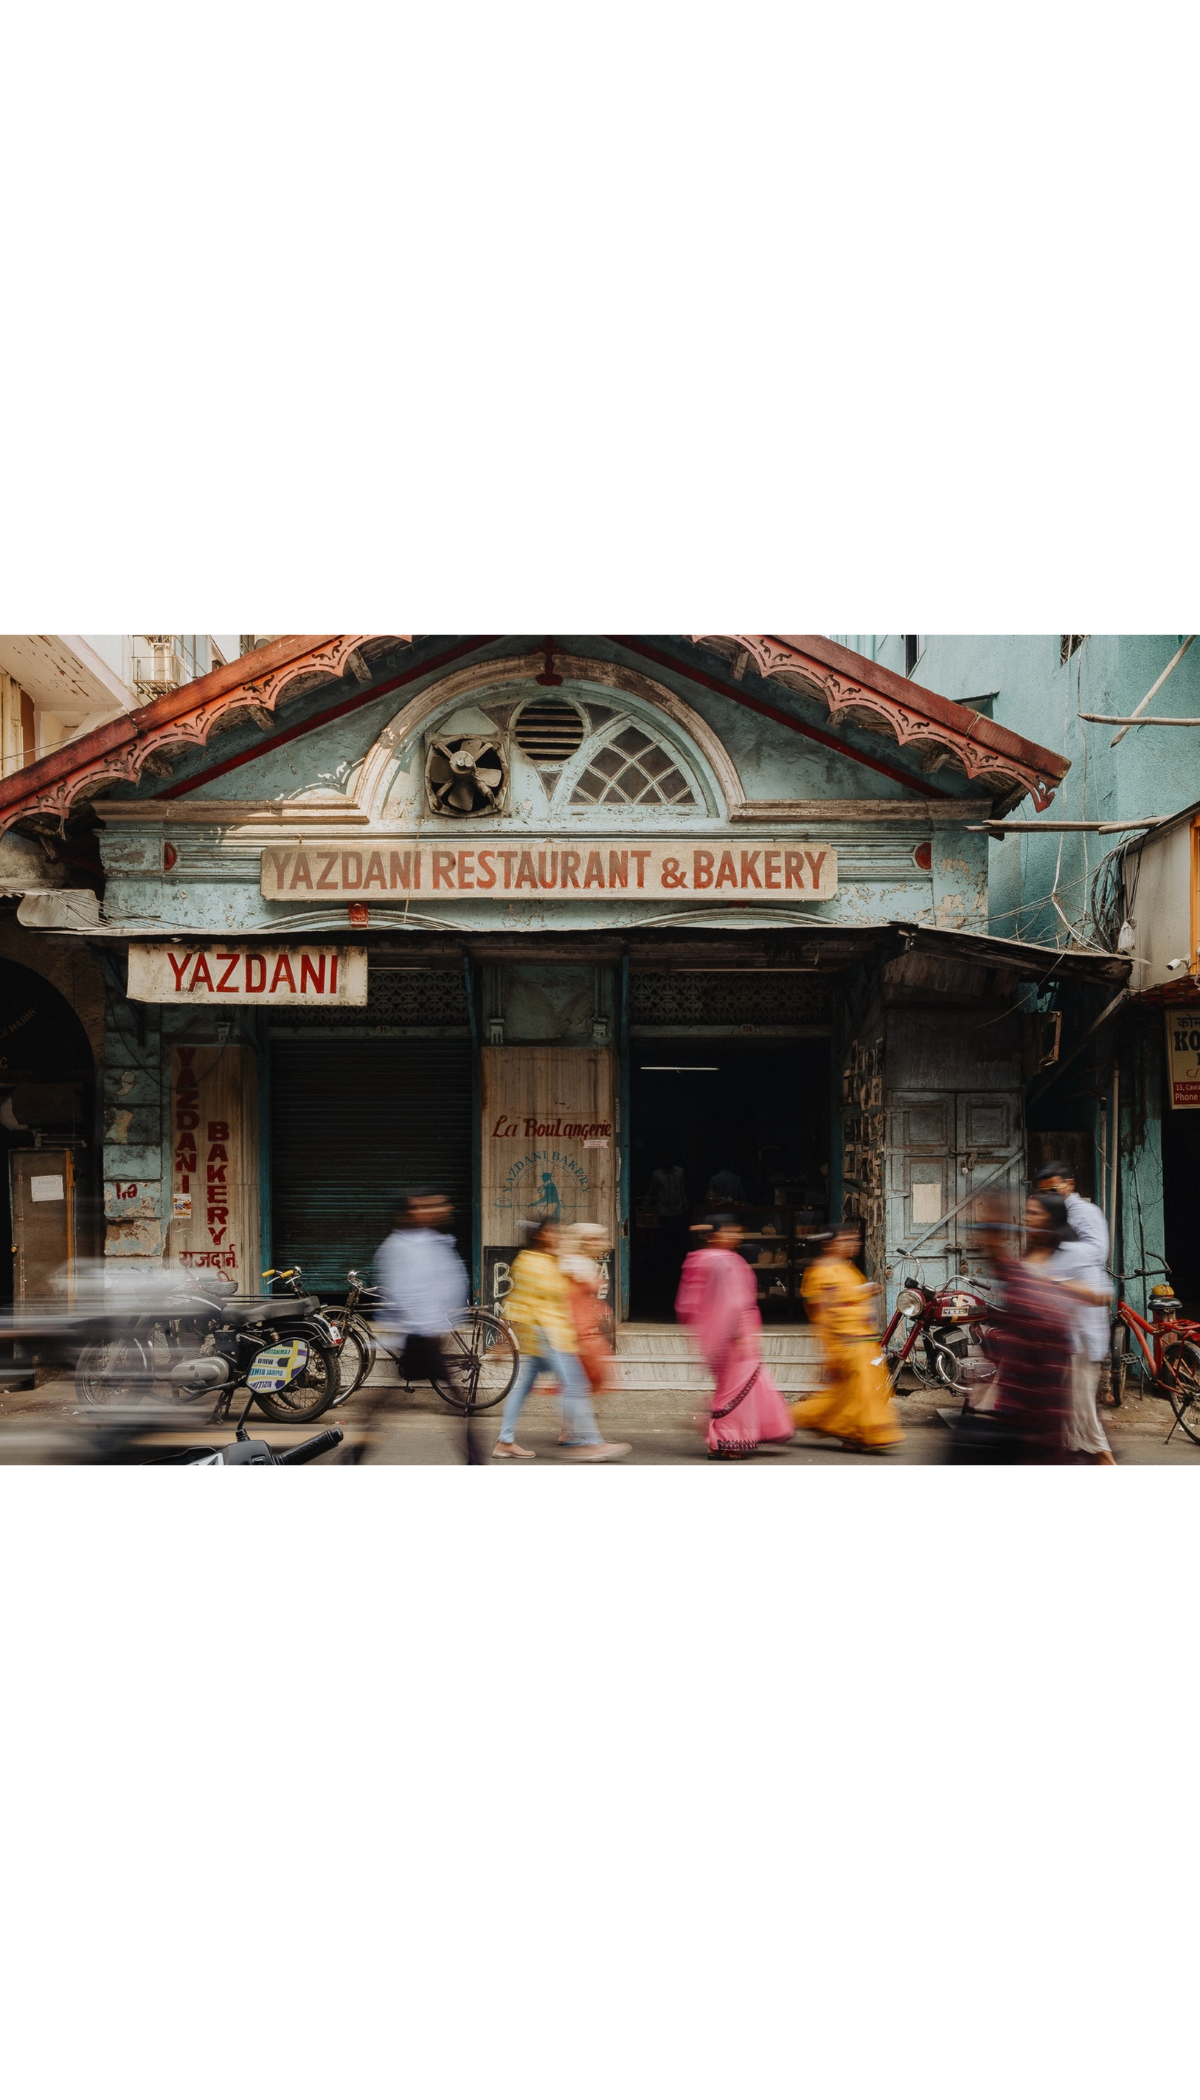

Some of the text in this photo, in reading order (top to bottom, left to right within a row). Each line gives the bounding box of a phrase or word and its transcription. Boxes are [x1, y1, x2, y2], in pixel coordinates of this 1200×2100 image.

[271, 849, 827, 890] YAZDANI RESTAURANT & BAKERY
[167, 952, 338, 994] YAZDANI
[8, 1007, 37, 1033] HABIB
[1175, 1084, 1185, 1092] 13,
[1175, 1092, 1199, 1101] Phone
[176, 1046, 199, 1193] YAZDANI
[490, 1114, 518, 1138] La
[207, 1121, 230, 1246] BAKERY
[502, 1150, 547, 1193] YAZDANI
[551, 1150, 591, 1193] BAKERY
